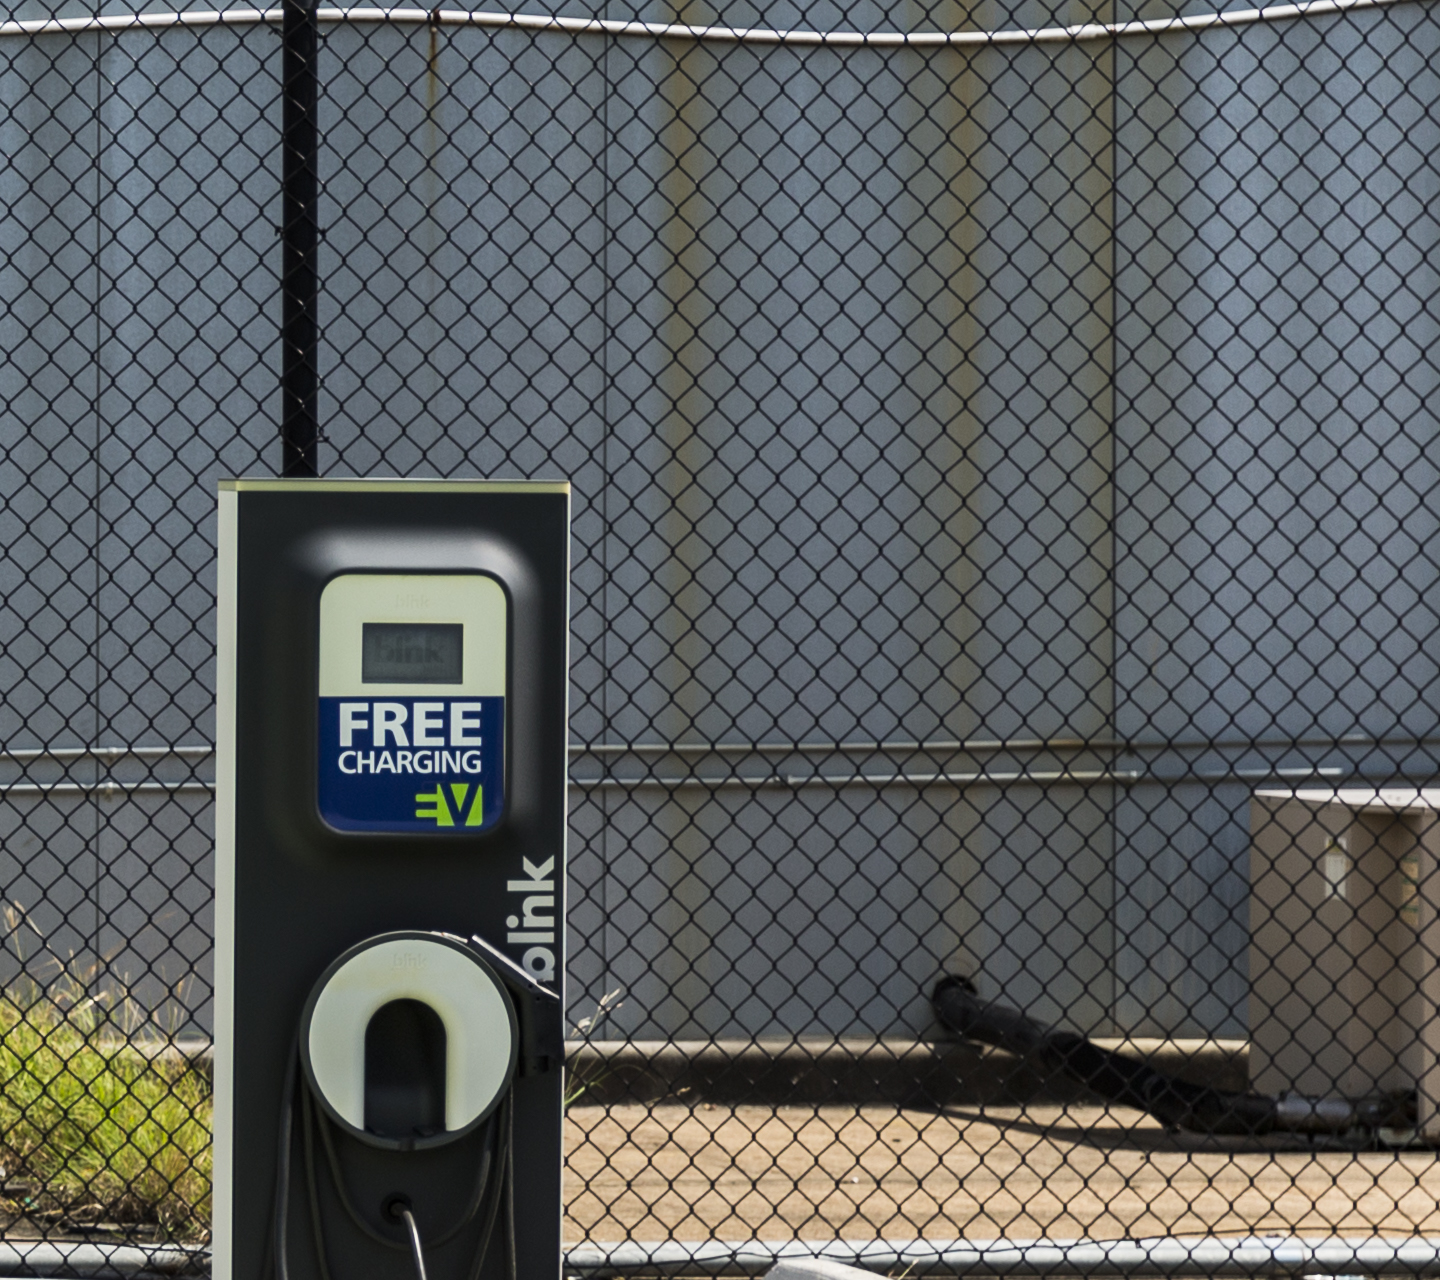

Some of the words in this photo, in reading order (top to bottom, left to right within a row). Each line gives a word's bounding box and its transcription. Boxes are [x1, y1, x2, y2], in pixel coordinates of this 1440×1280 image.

[339, 701, 482, 747] FREE
[337, 749, 482, 775] CHARGING
[415, 783, 483, 827] EV
[505, 854, 556, 983] blink
